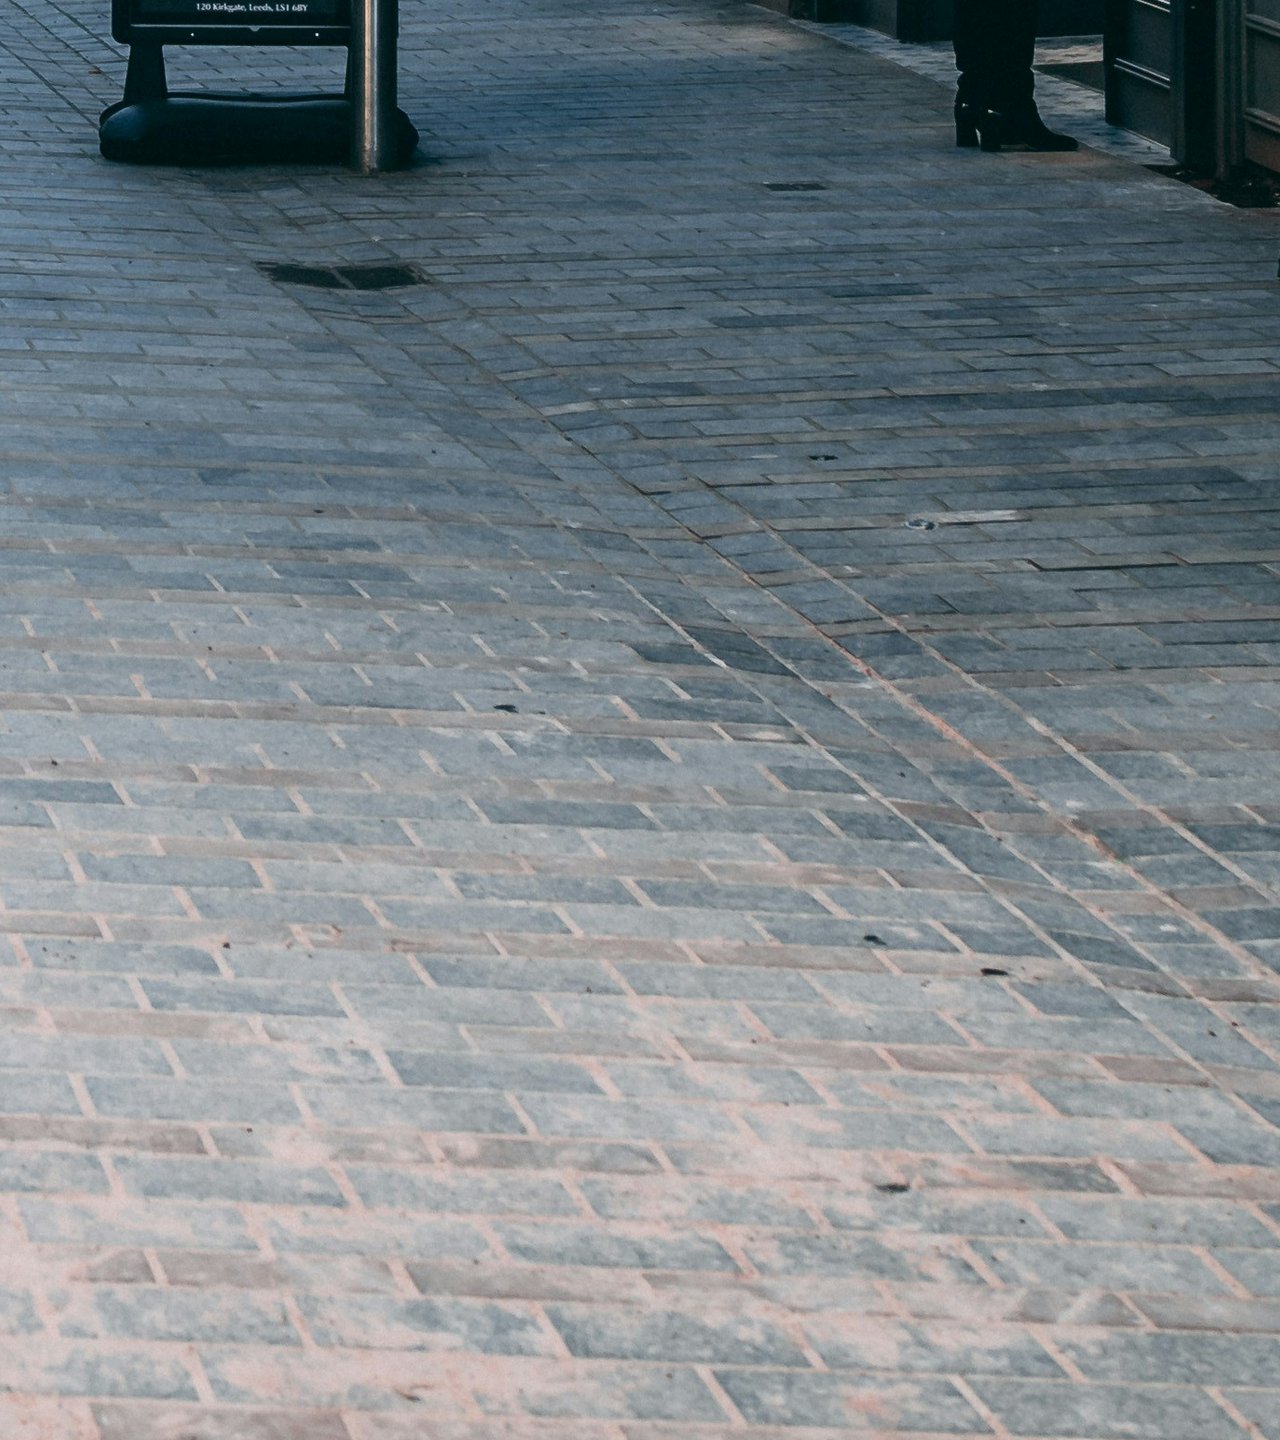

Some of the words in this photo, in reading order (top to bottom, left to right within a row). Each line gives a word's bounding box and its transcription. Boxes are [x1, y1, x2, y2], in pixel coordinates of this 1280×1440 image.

[196, 3, 211, 11] 120
[212, 3, 247, 13] Kirkgate,
[248, 3, 274, 12] Leeds,
